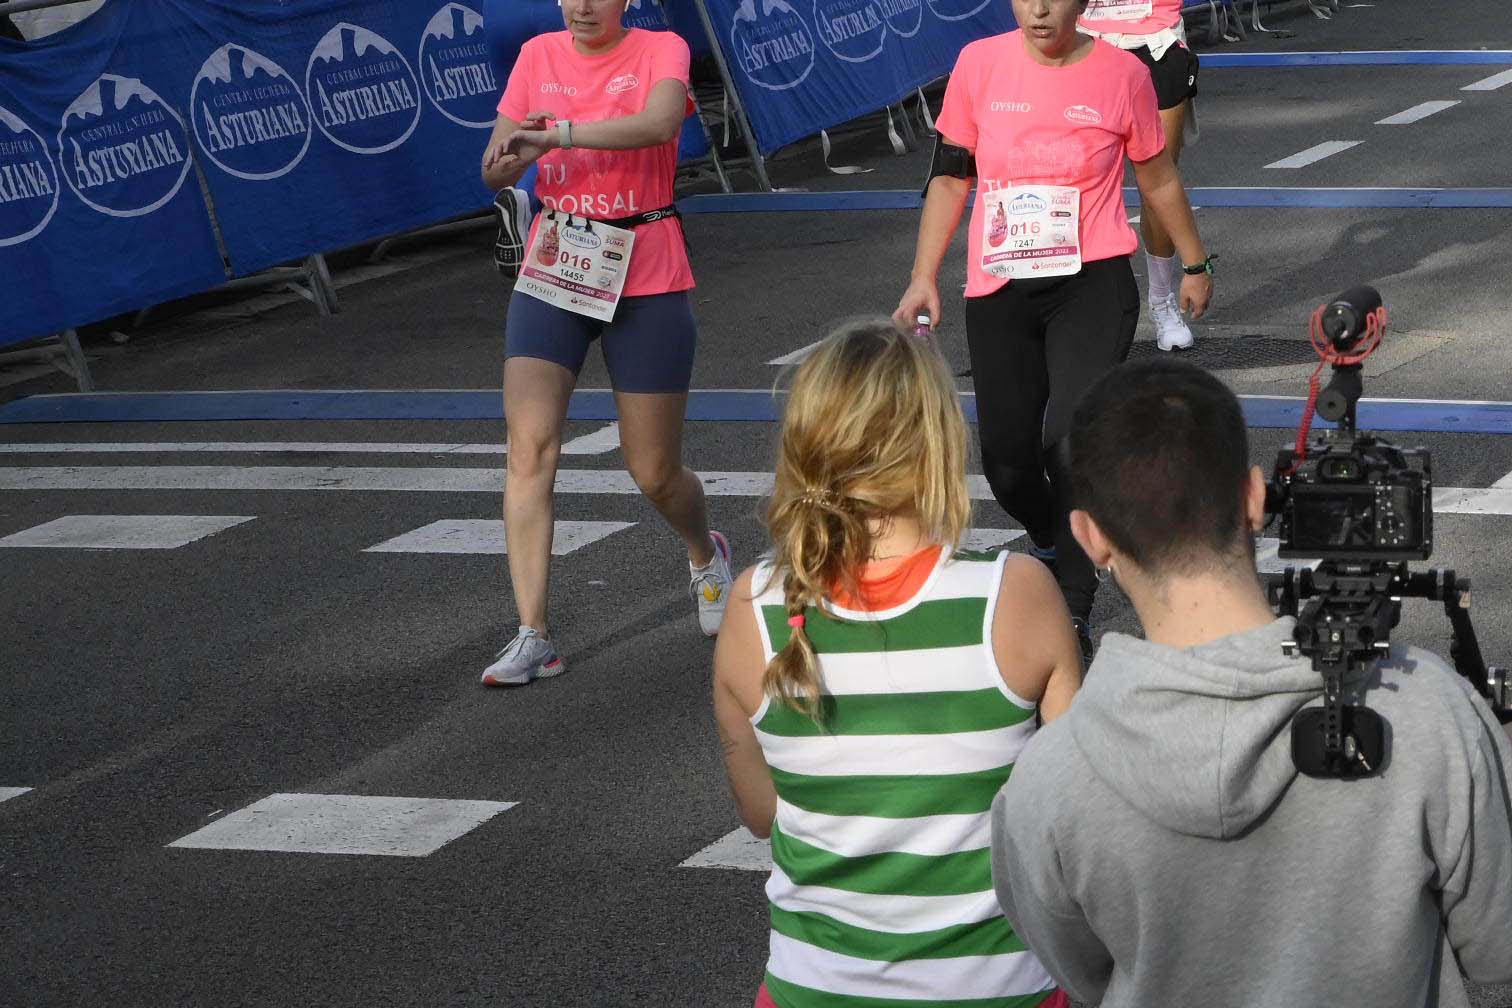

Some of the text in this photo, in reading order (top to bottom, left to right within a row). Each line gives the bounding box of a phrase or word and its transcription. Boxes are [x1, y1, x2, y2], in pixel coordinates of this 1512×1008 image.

[315, 76, 418, 128] ASTURIANA
[990, 100, 1033, 113] OYSHO
[202, 99, 307, 153] ASTURIANA
[543, 163, 567, 185] TU
[543, 190, 640, 215] DORSAL
[1010, 221, 1042, 236] 016
[1013, 238, 1035, 248] 7247
[560, 250, 593, 272] 016
[1023, 250, 1032, 258] LA
[560, 267, 585, 283] 14455
[526, 280, 558, 299] OYSHO
